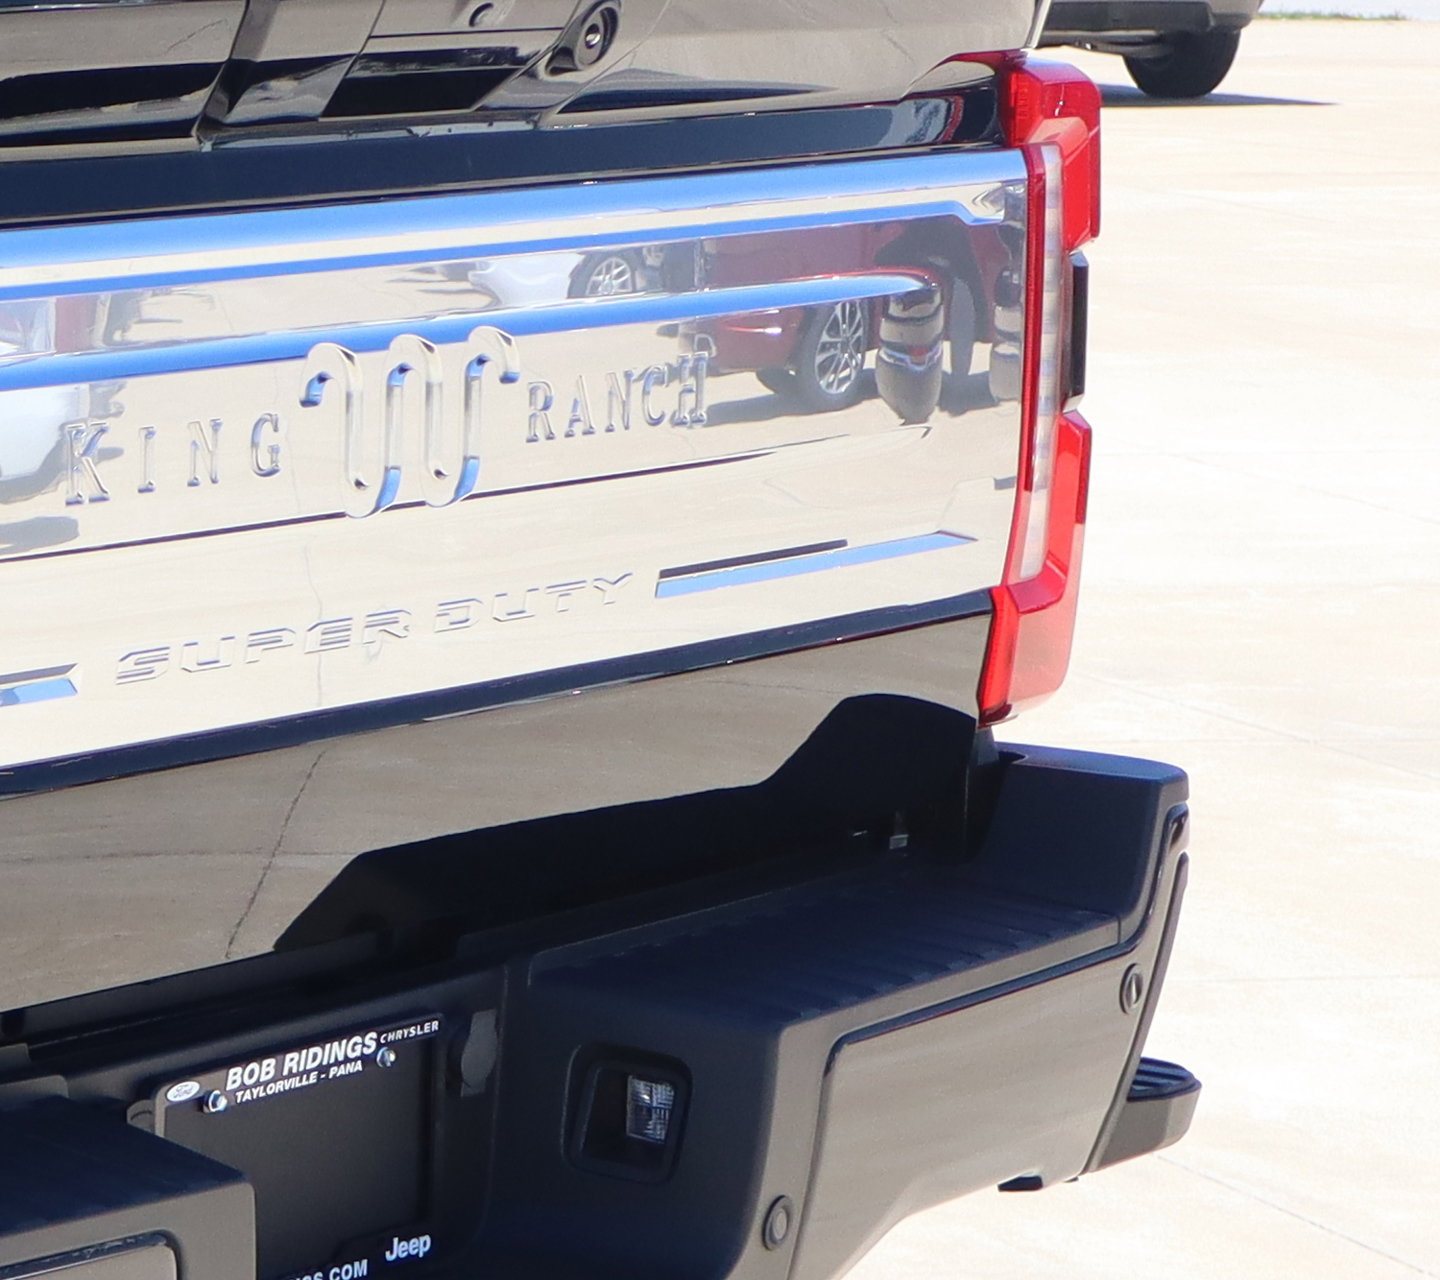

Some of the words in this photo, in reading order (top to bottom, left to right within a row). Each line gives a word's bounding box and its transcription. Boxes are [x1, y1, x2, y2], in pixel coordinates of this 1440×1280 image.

[64, 410, 282, 507] KING
[525, 348, 711, 445] RANCH
[114, 606, 412, 686] SUPER
[434, 571, 636, 634] DUTY
[380, 1020, 440, 1044] CHRYSLER
[225, 1058, 277, 1091] BOB
[282, 1031, 378, 1077] RIDINGS
[234, 1071, 319, 1104] TAYLORVILLE
[329, 1059, 363, 1080] PANA
[385, 1234, 432, 1262] Jeep
